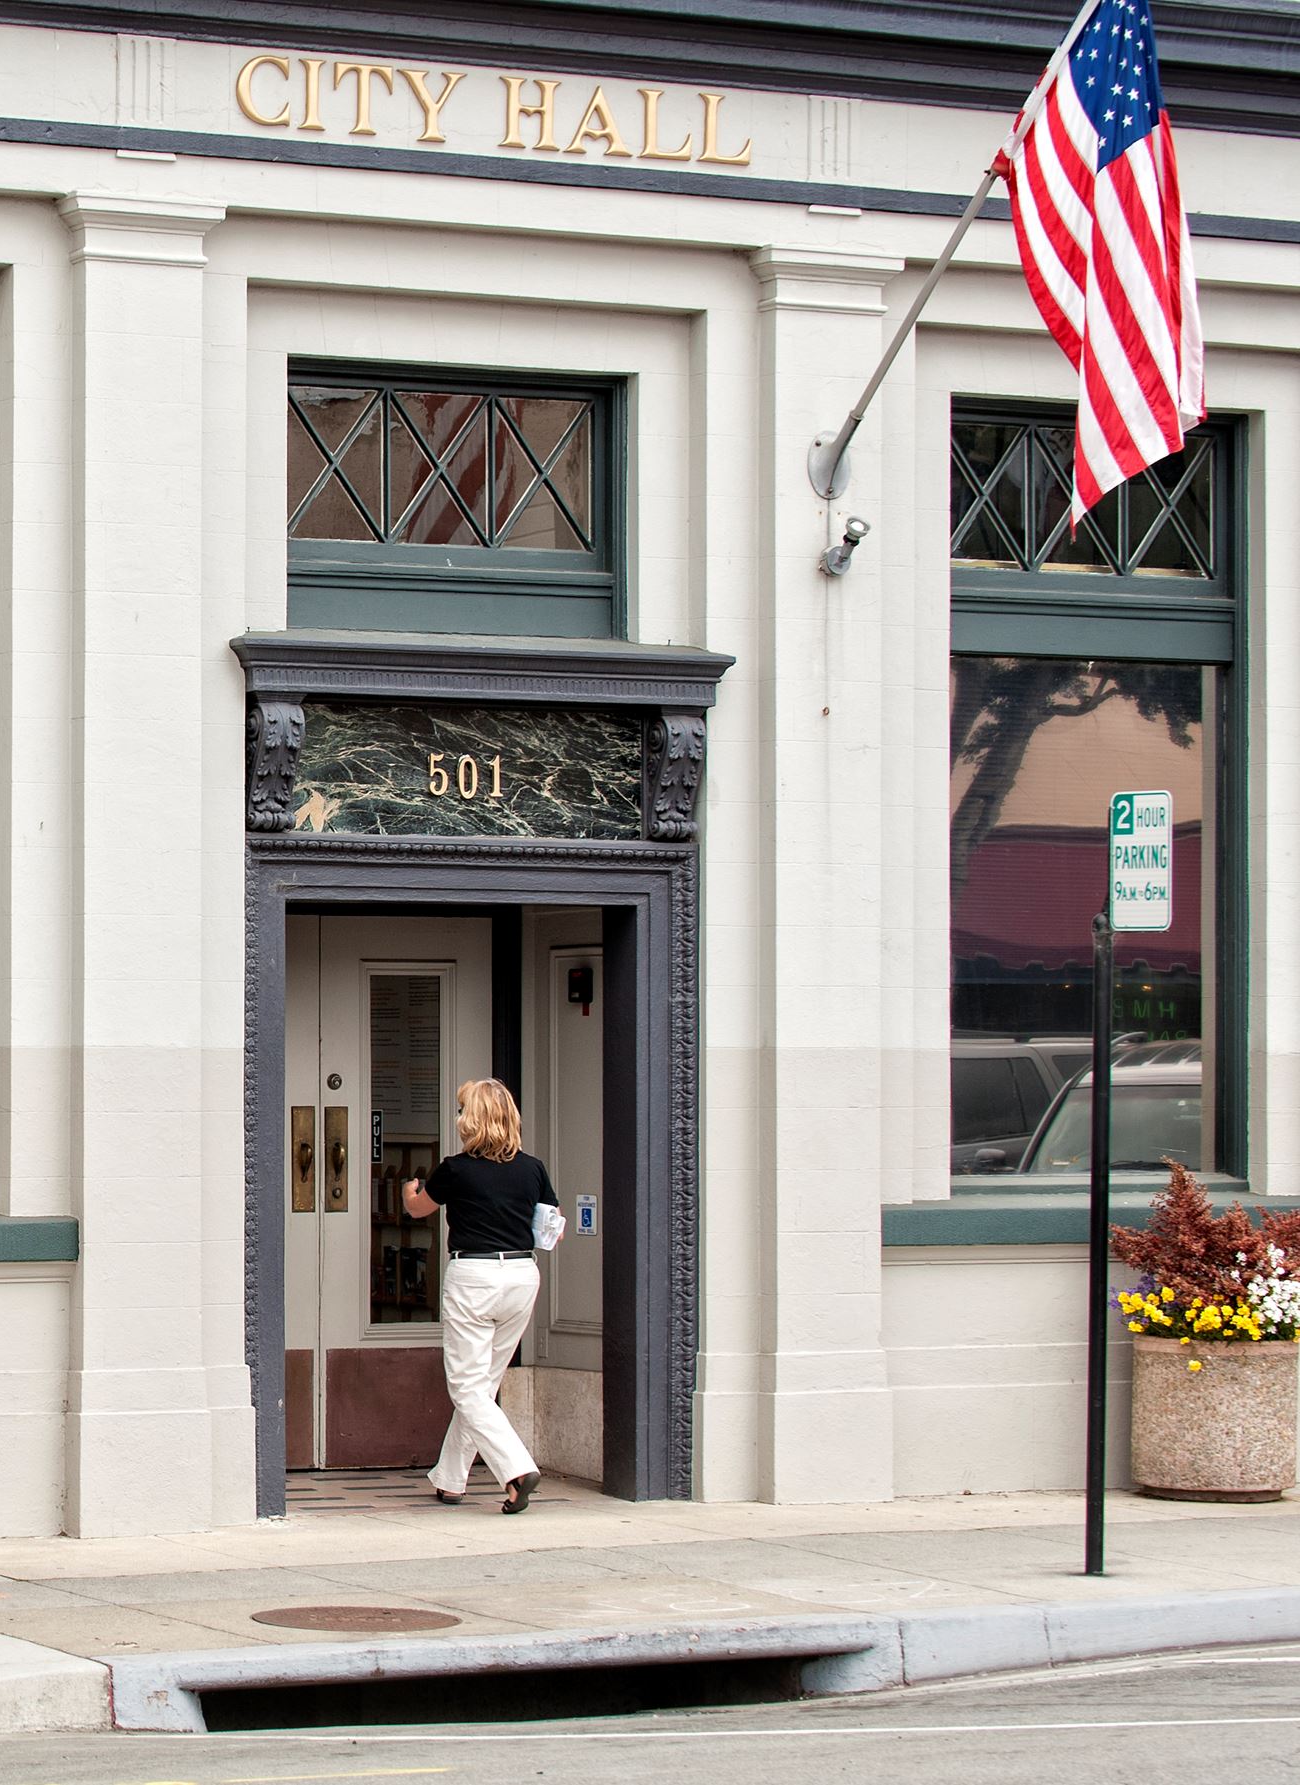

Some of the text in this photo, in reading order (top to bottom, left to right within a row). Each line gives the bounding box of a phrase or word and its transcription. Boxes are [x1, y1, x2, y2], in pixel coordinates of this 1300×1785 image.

[235, 54, 752, 167] CITY HALL
[427, 753, 504, 800] 501
[1116, 800, 1166, 829] 2 HOUR
[1114, 845, 1167, 869] PARKING
